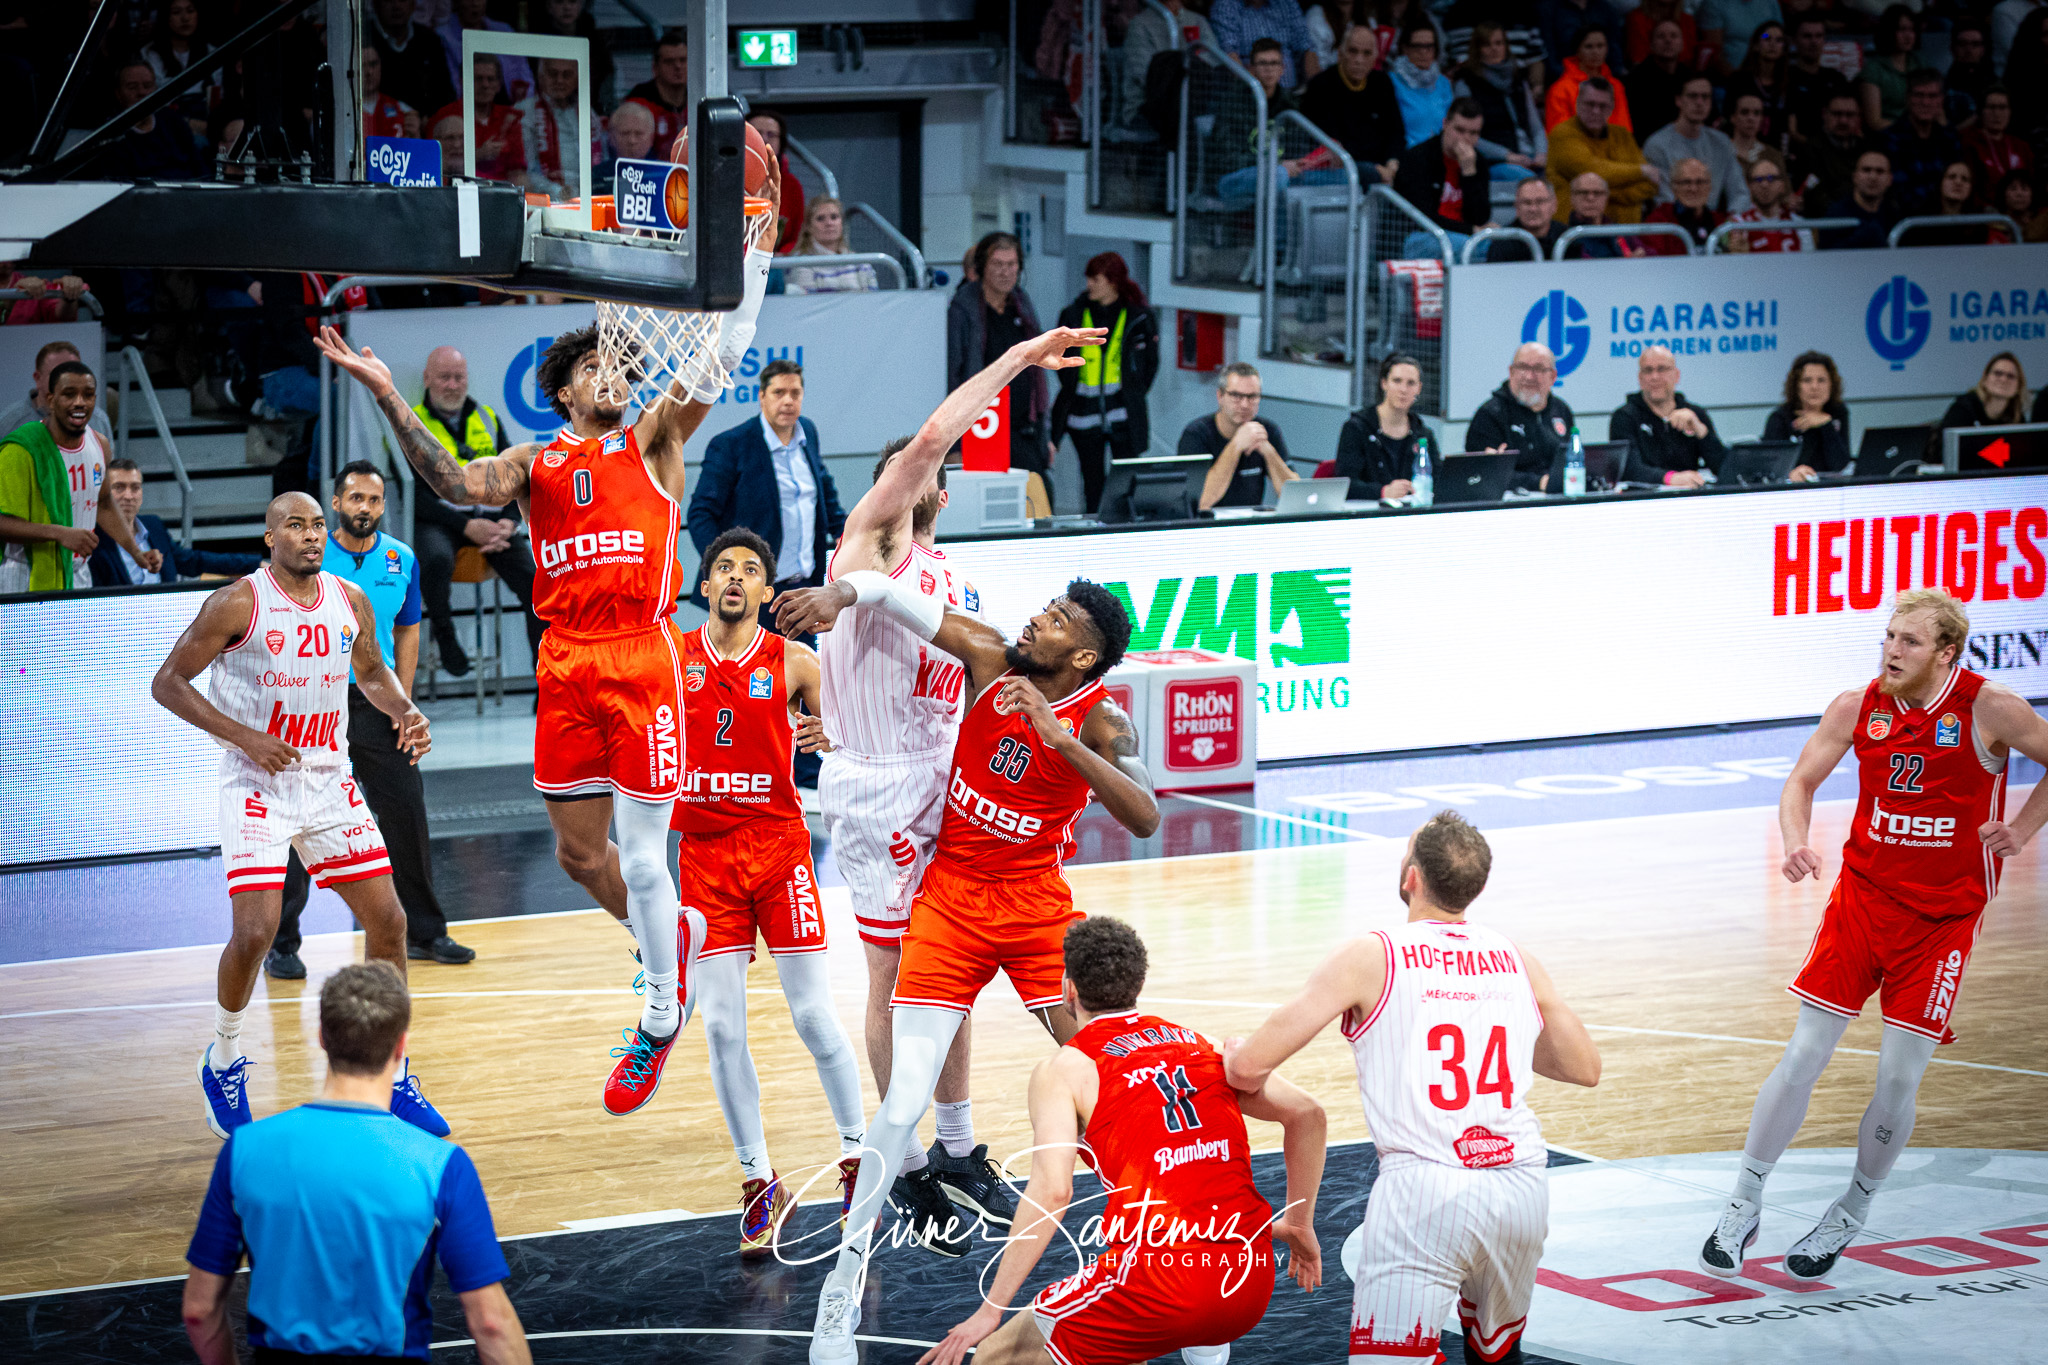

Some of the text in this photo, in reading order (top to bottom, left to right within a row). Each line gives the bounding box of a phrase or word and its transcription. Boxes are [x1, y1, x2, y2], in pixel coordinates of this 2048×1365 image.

[370, 144, 411, 178] e@sy
[621, 166, 644, 182] e@sy
[631, 179, 656, 195] Credit
[622, 195, 656, 223] BBL
[1611, 300, 1778, 333] IGARASHI
[1950, 322, 2046, 343] MOTOREN
[1718, 334, 1777, 353] GMBH
[971, 397, 1001, 439] 5
[68, 463, 86, 492] 11
[573, 469, 593, 506] 0
[540, 530, 645, 569] brose
[575, 558, 589, 570] für
[591, 554, 644, 567] Automobile
[1773, 507, 2048, 617] HEUTIGES
[297, 624, 330, 658] 20
[256, 670, 310, 688] s.Oliver
[751, 687, 769, 697] BBL
[715, 708, 733, 746] 2
[1173, 716, 1234, 735] SPRUDEL
[1938, 735, 1957, 745] BBL
[989, 736, 1032, 784] 35
[1887, 753, 1925, 793] 22
[947, 794, 968, 819] Technik
[968, 815, 981, 827] für
[950, 766, 1043, 837] brose
[1884, 835, 1898, 845] für
[1899, 838, 1953, 848] Automobile
[1402, 944, 1517, 976] HOFFMANN
[1427, 1023, 1514, 1111] 34
[1154, 1138, 1230, 1175] Bamberg
[1664, 1277, 2033, 1330] Technik für
